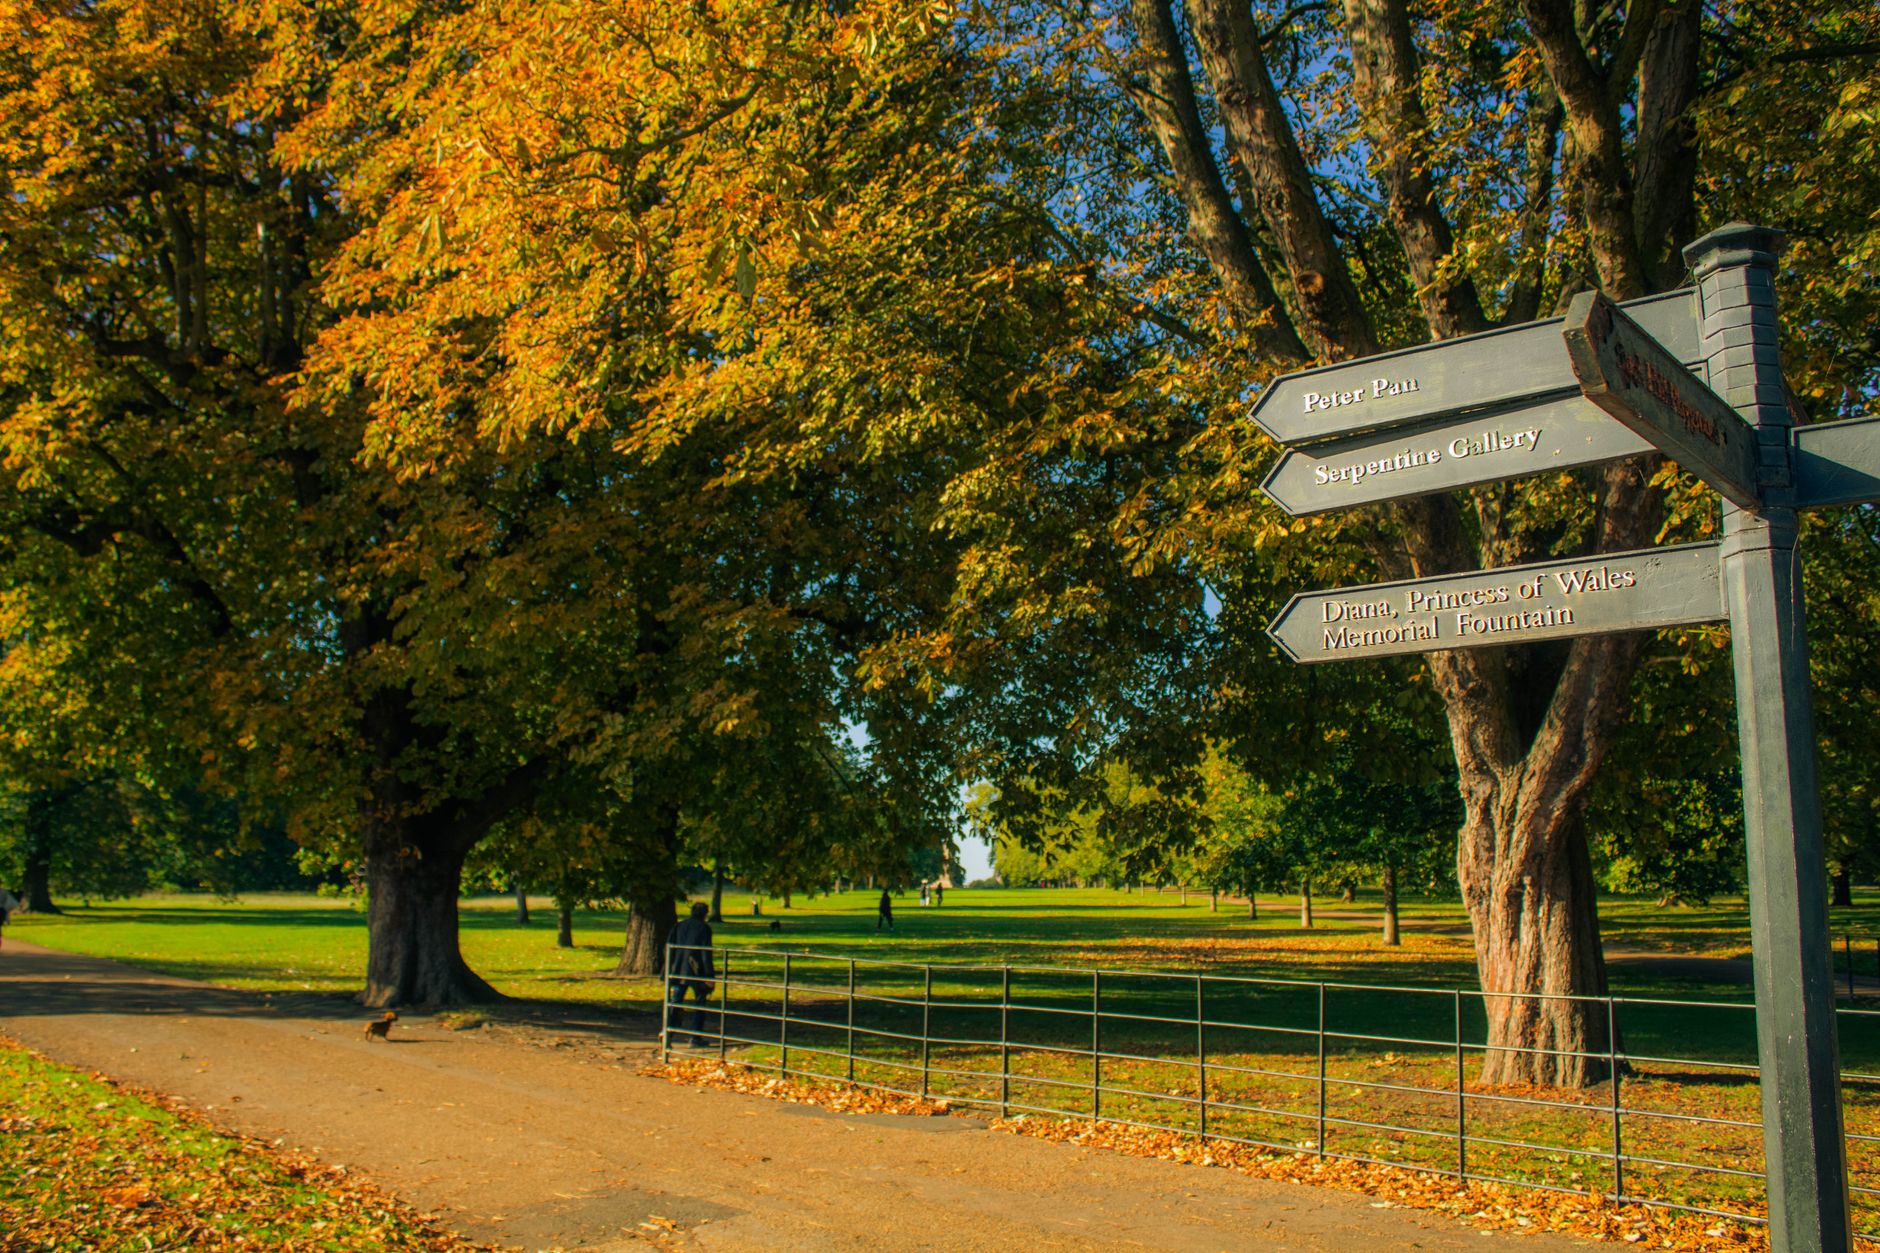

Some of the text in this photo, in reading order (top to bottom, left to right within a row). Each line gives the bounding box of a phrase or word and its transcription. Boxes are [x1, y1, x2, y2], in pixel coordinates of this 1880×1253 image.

[1303, 377, 1420, 413] Peter Pan
[1314, 428, 1543, 485] Serpentine Gallery
[1322, 566, 1636, 623] Diana, Princess of Wales
[1323, 605, 1574, 650] Memorial Fountain
